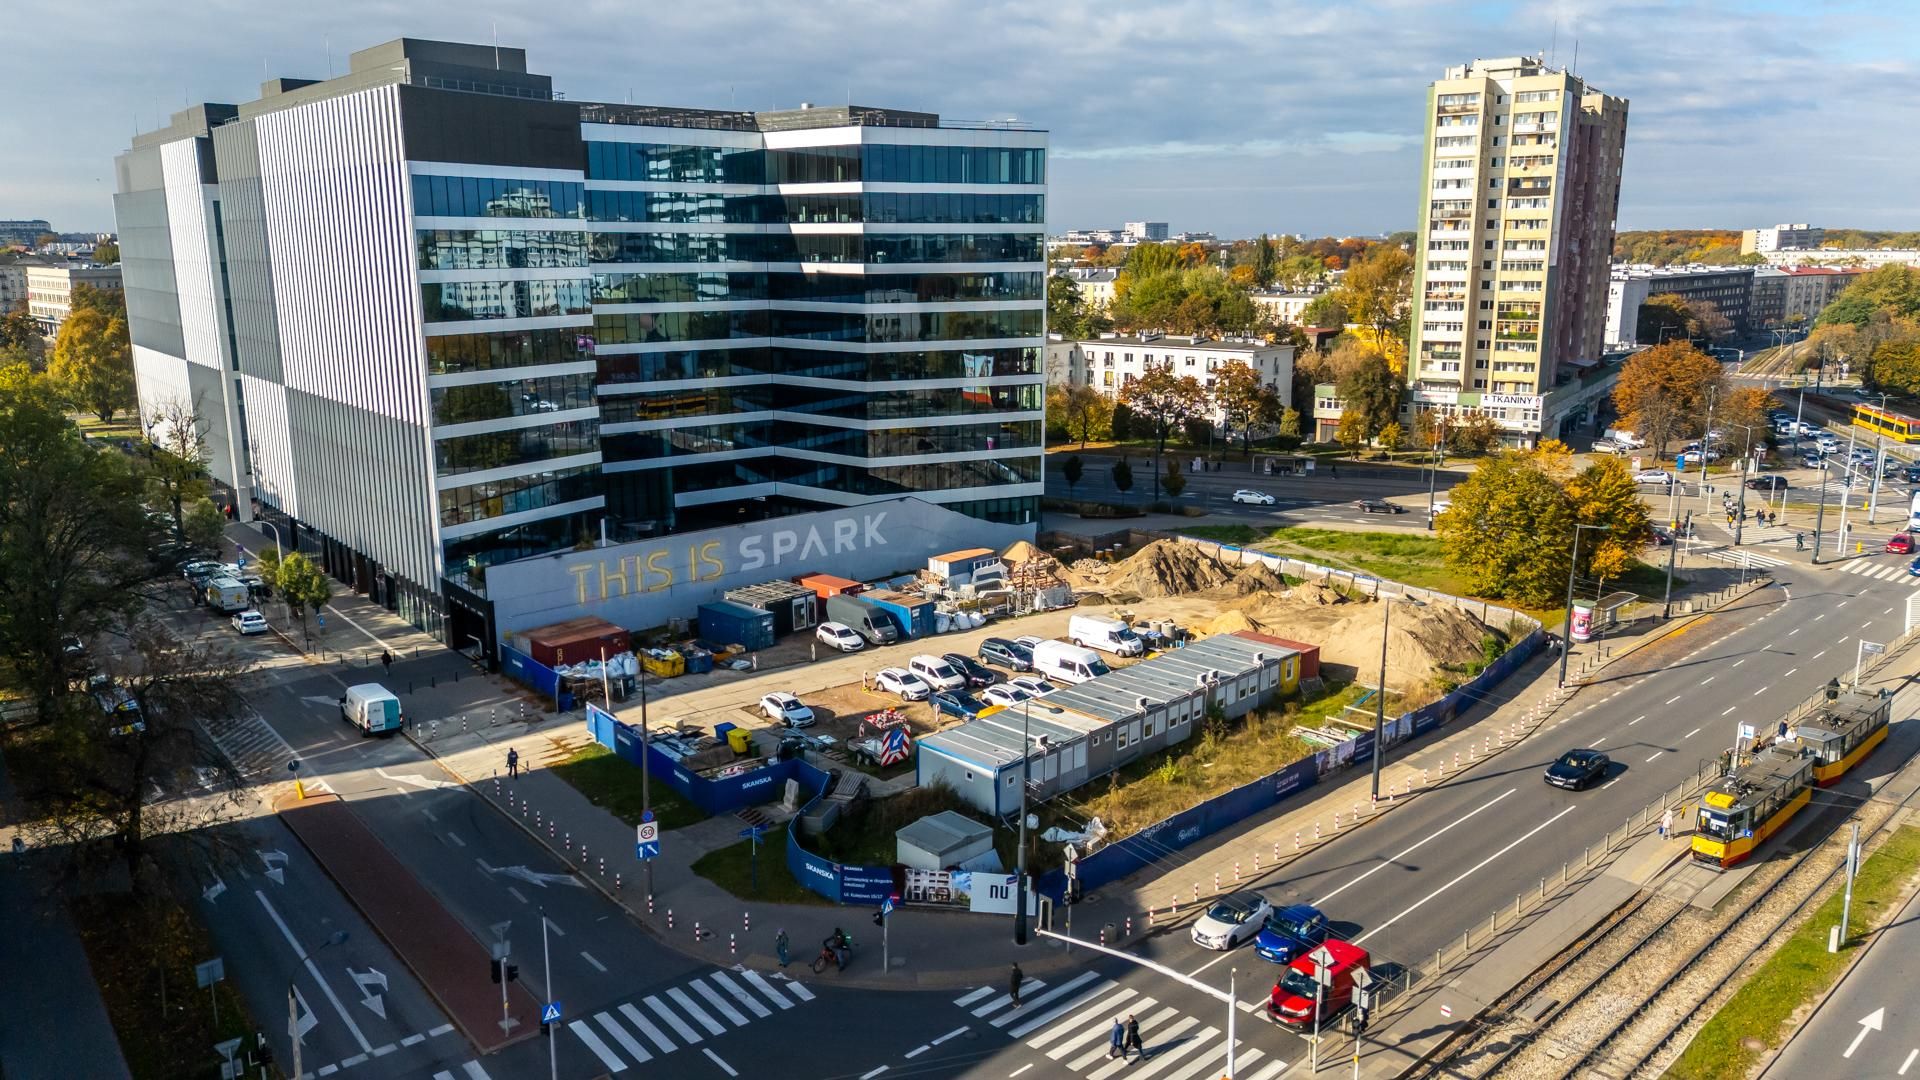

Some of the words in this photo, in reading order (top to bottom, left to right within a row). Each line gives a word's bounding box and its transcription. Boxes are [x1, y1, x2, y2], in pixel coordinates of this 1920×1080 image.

[1492, 395, 1533, 405] TKANINY
[567, 549, 673, 604] THIS
[688, 540, 724, 582] IS
[739, 511, 888, 572] SPARK
[742, 776, 772, 790] SKANSKA
[805, 863, 834, 880] SKANSKA
